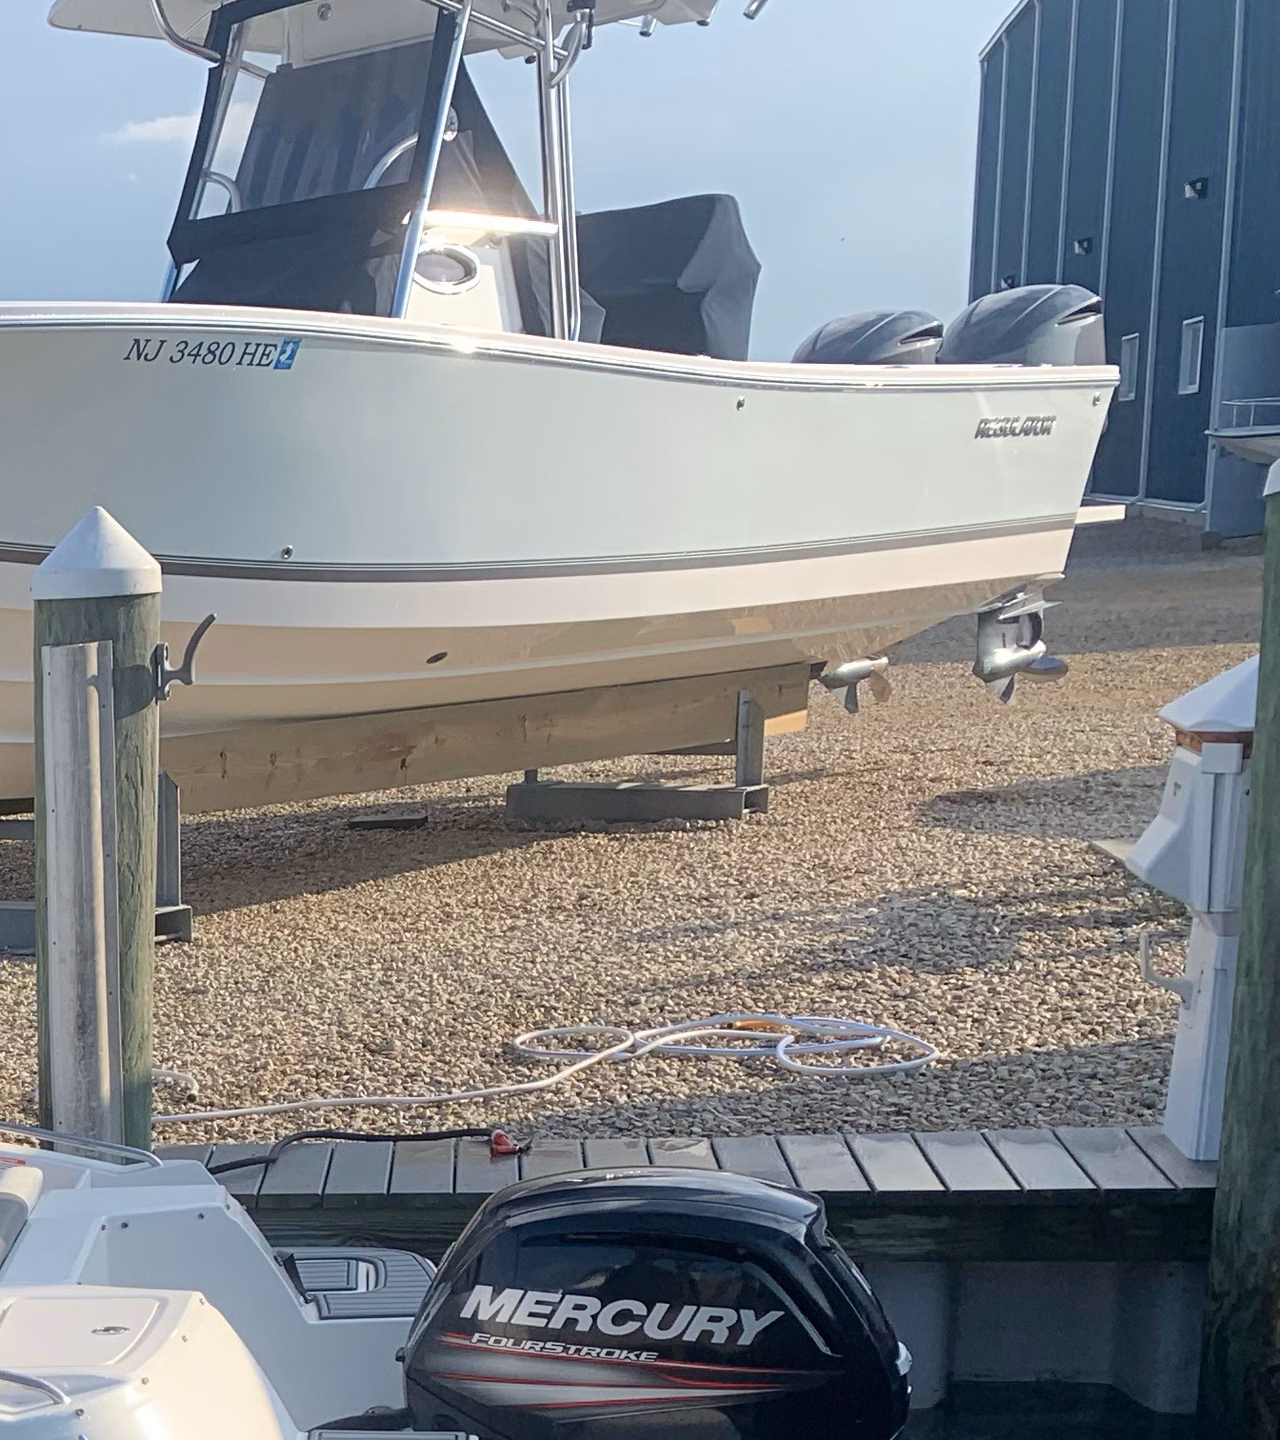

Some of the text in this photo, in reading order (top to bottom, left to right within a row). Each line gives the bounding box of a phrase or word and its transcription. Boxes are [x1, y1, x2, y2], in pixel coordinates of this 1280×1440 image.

[123, 337, 279, 368] NJ 3480 HE
[459, 1283, 786, 1346] MERCURY
